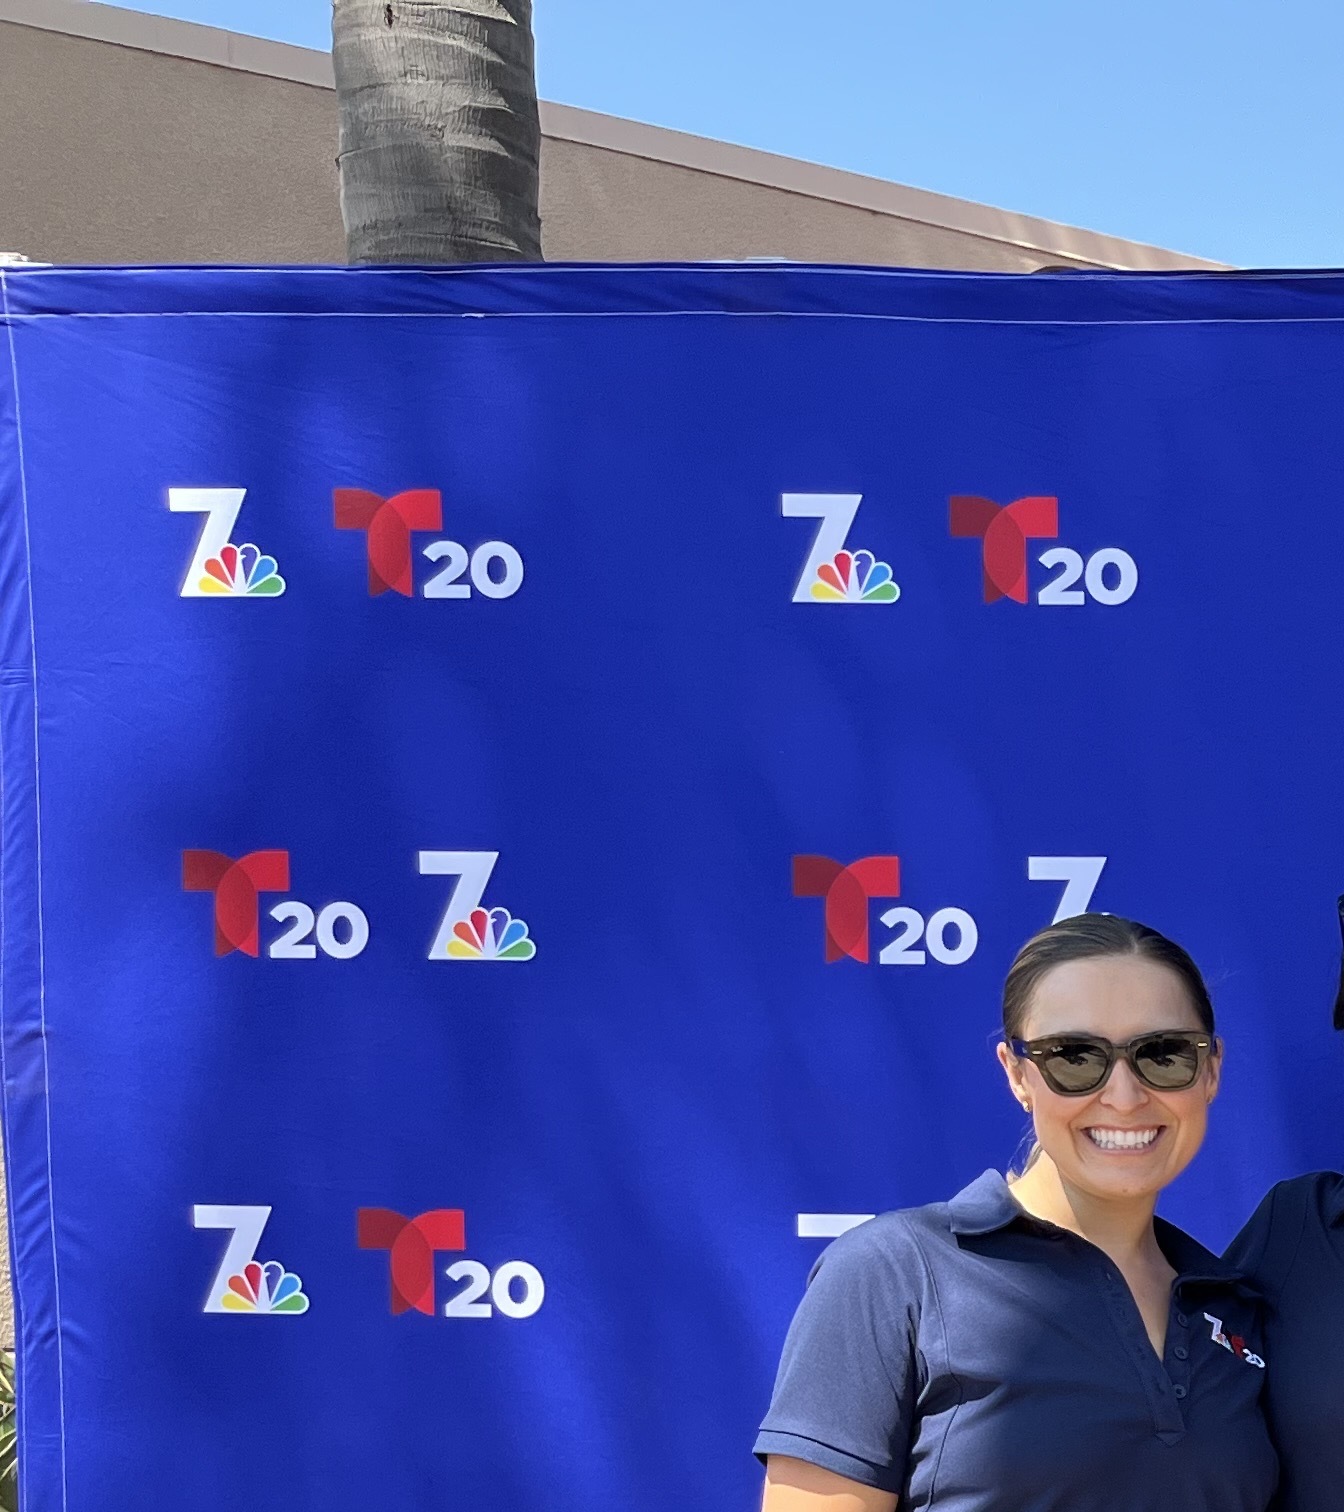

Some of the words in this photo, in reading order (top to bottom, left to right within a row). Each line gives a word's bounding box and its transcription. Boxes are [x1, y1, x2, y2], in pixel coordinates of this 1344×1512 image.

[168, 488, 248, 597] 7
[781, 494, 863, 603] 7
[419, 850, 499, 961] 7
[193, 1205, 273, 1314] 7
